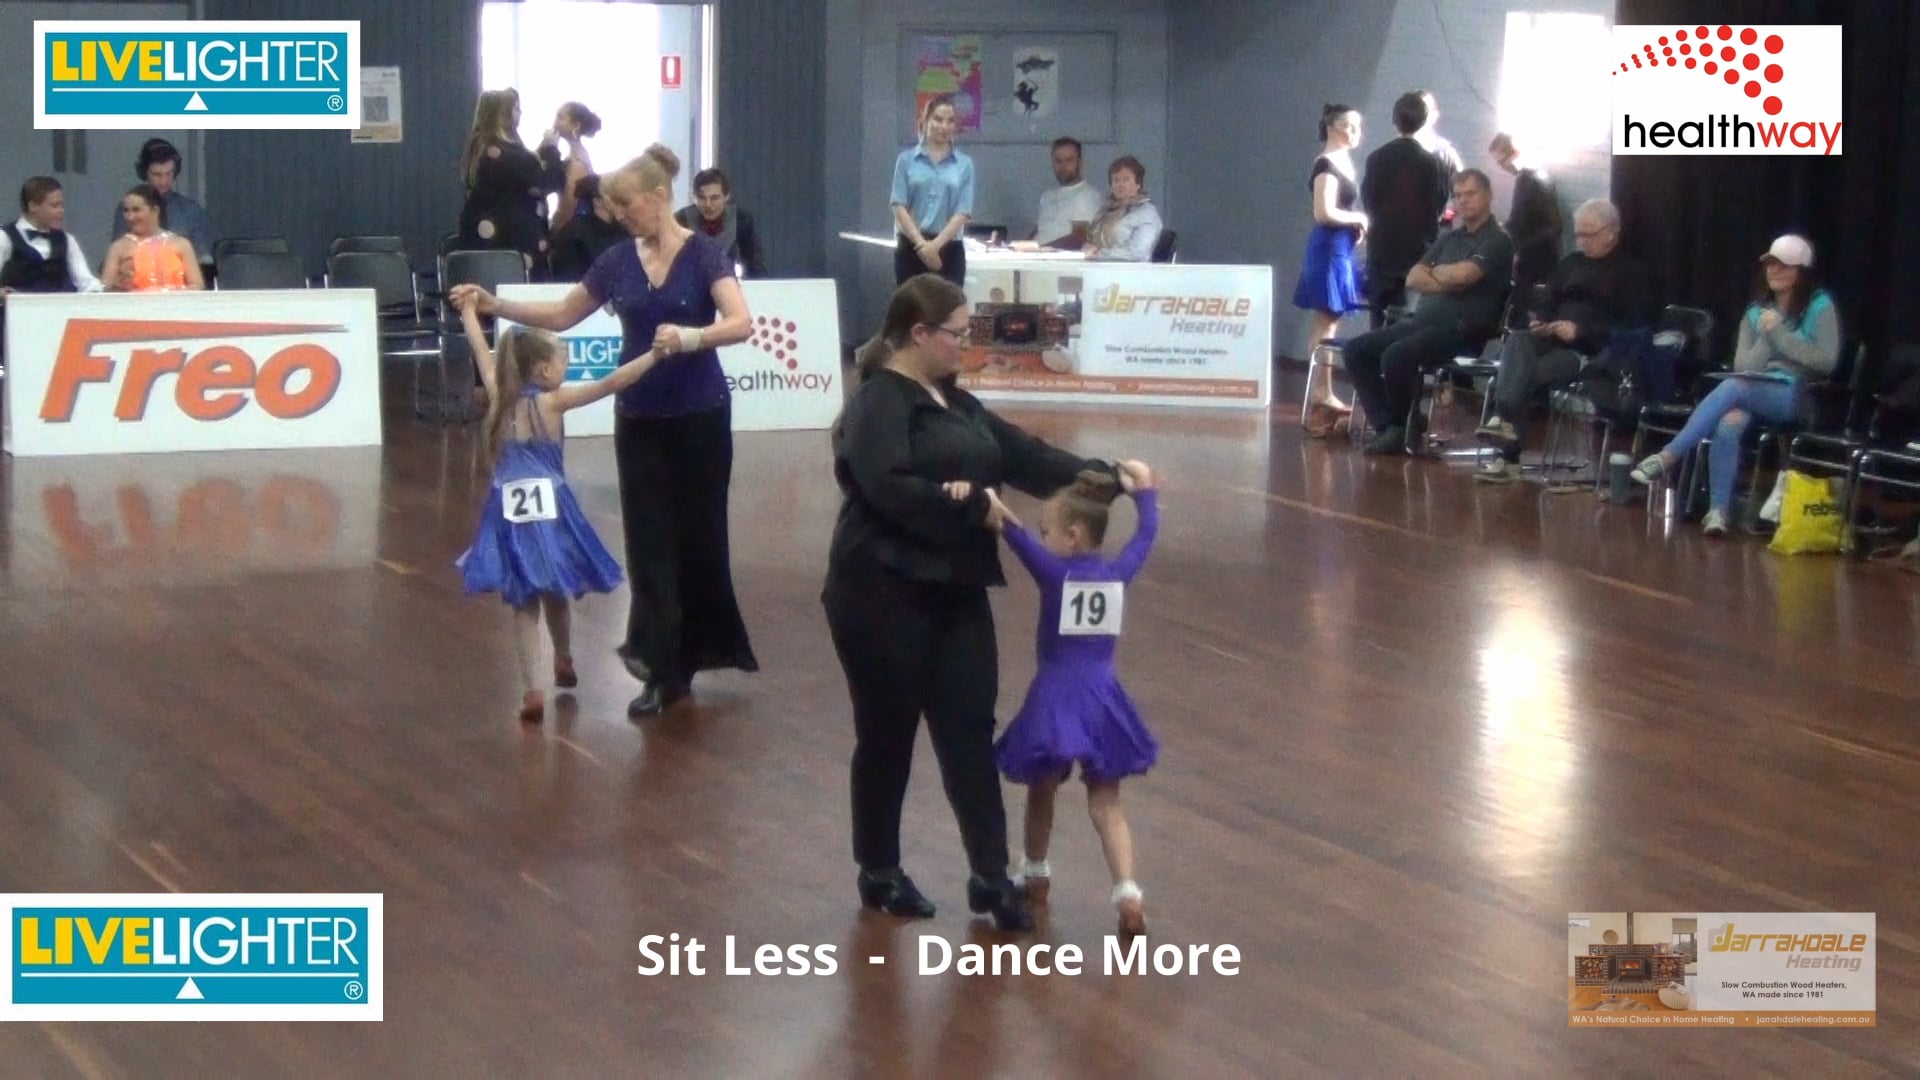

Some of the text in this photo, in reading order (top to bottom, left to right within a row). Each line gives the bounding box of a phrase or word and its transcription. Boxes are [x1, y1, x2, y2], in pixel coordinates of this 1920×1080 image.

[1169, 318, 1247, 337] Heating
[38, 318, 349, 423] Freo
[726, 369, 832, 393] ealthway
[511, 485, 543, 517] 21
[1803, 500, 1838, 517] rebe
[1070, 590, 1106, 626] 19
